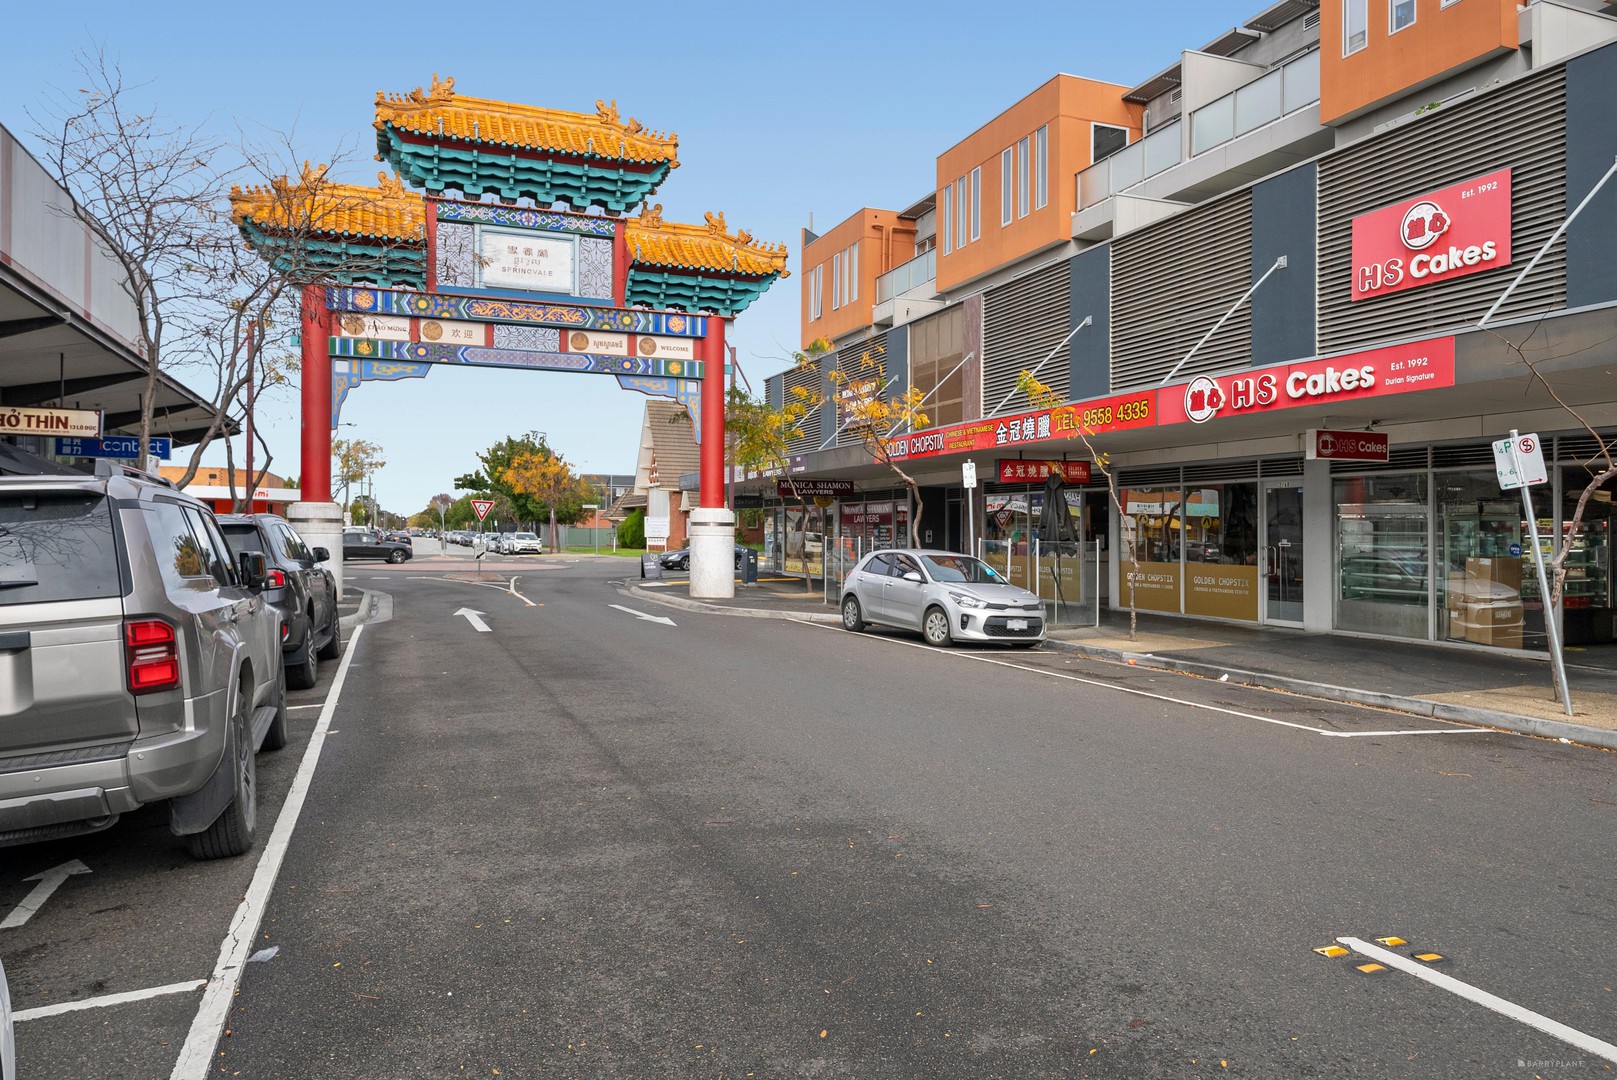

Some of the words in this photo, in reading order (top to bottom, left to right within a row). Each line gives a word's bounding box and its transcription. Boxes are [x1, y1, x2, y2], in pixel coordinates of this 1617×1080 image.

[1461, 188, 1476, 199] Est.
[1477, 181, 1498, 195] 1992
[501, 266, 553, 277] SPRINGVALE
[1358, 258, 1404, 292] HS
[1409, 240, 1497, 279] Cakes
[451, 328, 474, 339] 欢迎
[1390, 361, 1405, 371] Est.
[1407, 357, 1428, 368] 1992
[1385, 377, 1405, 386] Durian
[1406, 373, 1435, 384] Signature
[1231, 373, 1278, 409] HS
[1286, 365, 1376, 399] Cakes
[24, 412, 69, 429] THÌN
[1083, 406, 1113, 427] 9558
[1116, 400, 1149, 421] 4335
[946, 429, 963, 439] CHINESE
[967, 424, 994, 436] VIETNAMESE
[911, 433, 945, 455] CHOPSTIX
[949, 439, 976, 450] RESTAURANT
[1338, 439, 1357, 453] HS
[1358, 440, 1387, 453] Cakes
[1503, 441, 1511, 453] P
[780, 481, 813, 489] MONICA
[1148, 573, 1174, 583] CHOPSTIX
[1193, 576, 1216, 585] GOLDEN
[1218, 577, 1249, 588] CHOPSTIX
